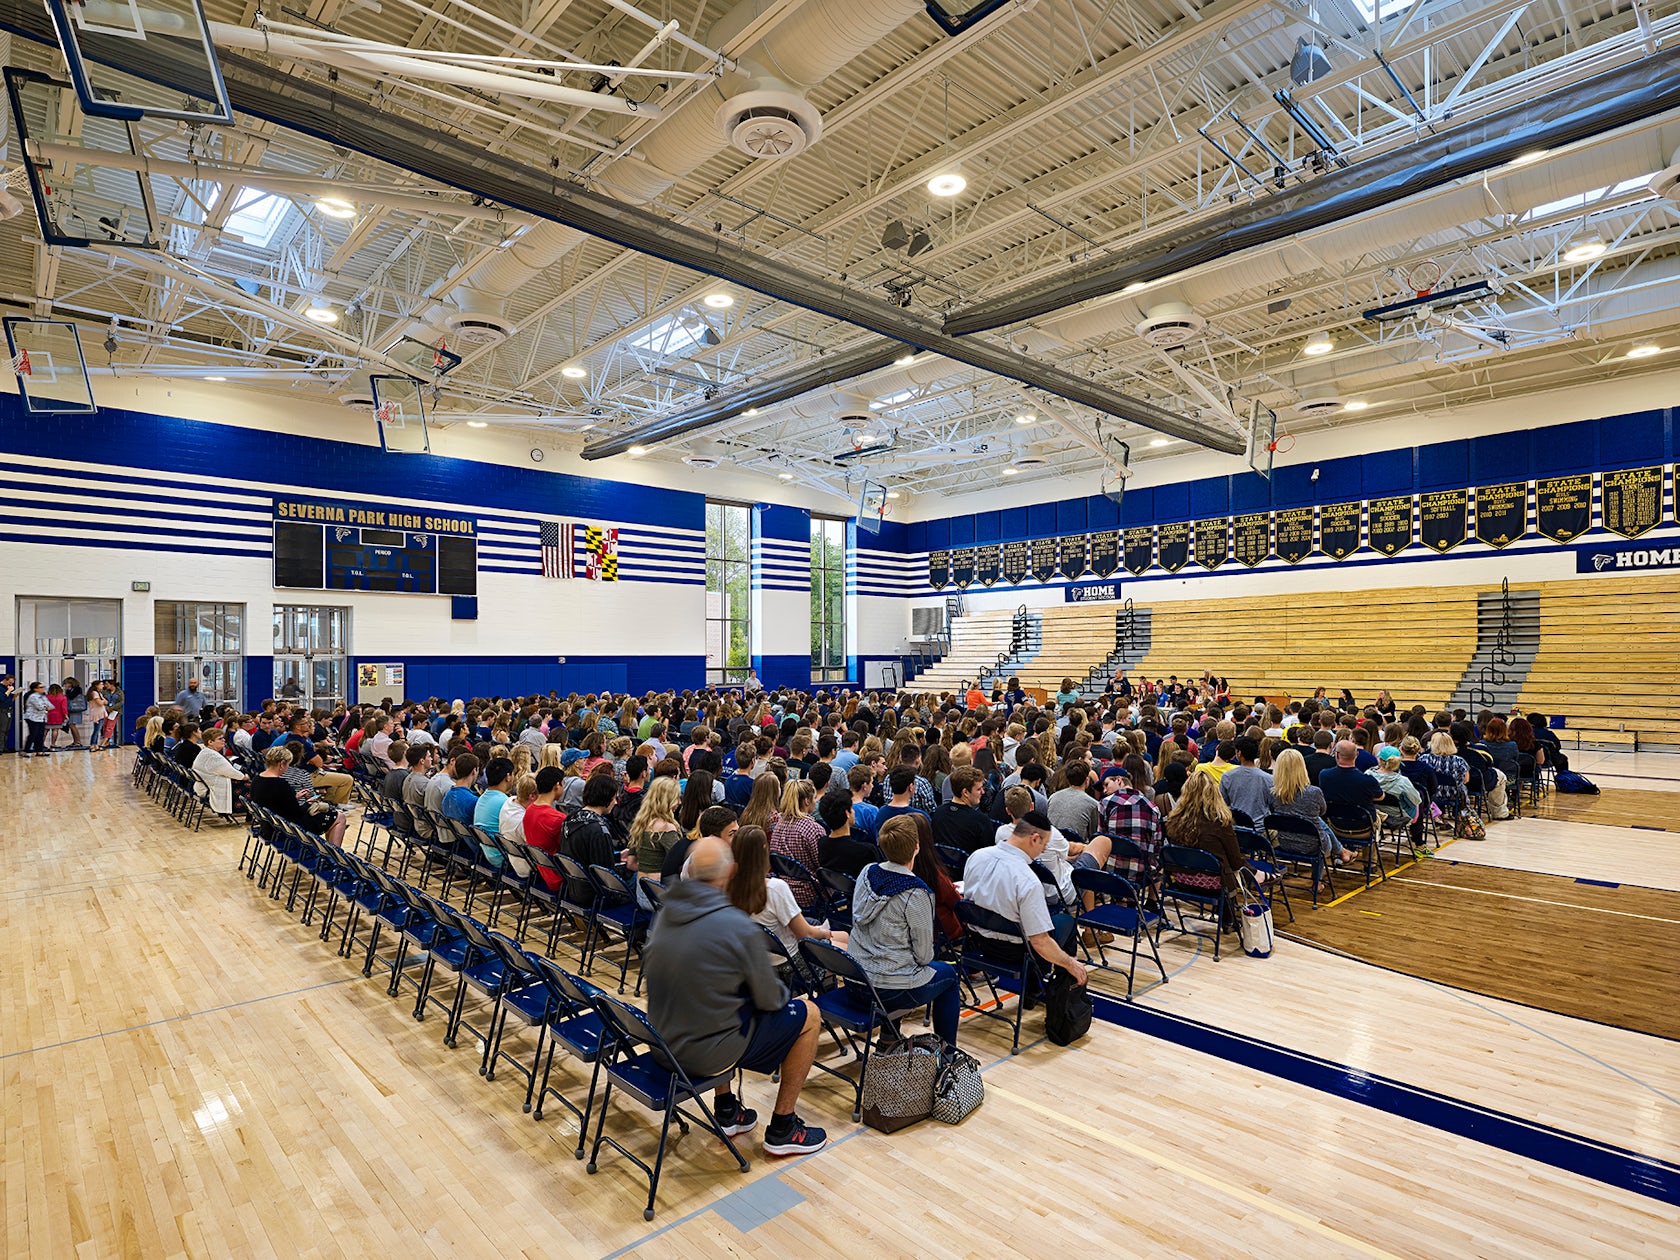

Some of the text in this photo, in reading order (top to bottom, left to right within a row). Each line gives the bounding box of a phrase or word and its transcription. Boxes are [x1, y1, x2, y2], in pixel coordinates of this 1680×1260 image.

[1614, 470, 1651, 481] STATE
[1546, 478, 1582, 488] STATE
[1604, 474, 1660, 487] CHAMPIONS
[1485, 486, 1517, 494] STATE
[1538, 484, 1590, 494] CHAMPIONS
[1428, 493, 1458, 501] STATE
[1478, 490, 1525, 501] CHAMPIONS
[1549, 496, 1578, 504] SWIMMING
[1376, 499, 1404, 507] STATE
[1422, 498, 1465, 508] CHAMPIONS
[1370, 504, 1410, 513] CHAMPIONS
[278, 502, 474, 533] SEVERNA PARK HIGH SCHOOL
[1322, 509, 1360, 518] CHAMPIONS
[1276, 515, 1312, 523] CHAMPIONS
[1234, 520, 1268, 528] CHAMPIONS
[1084, 585, 1115, 596] HOME
